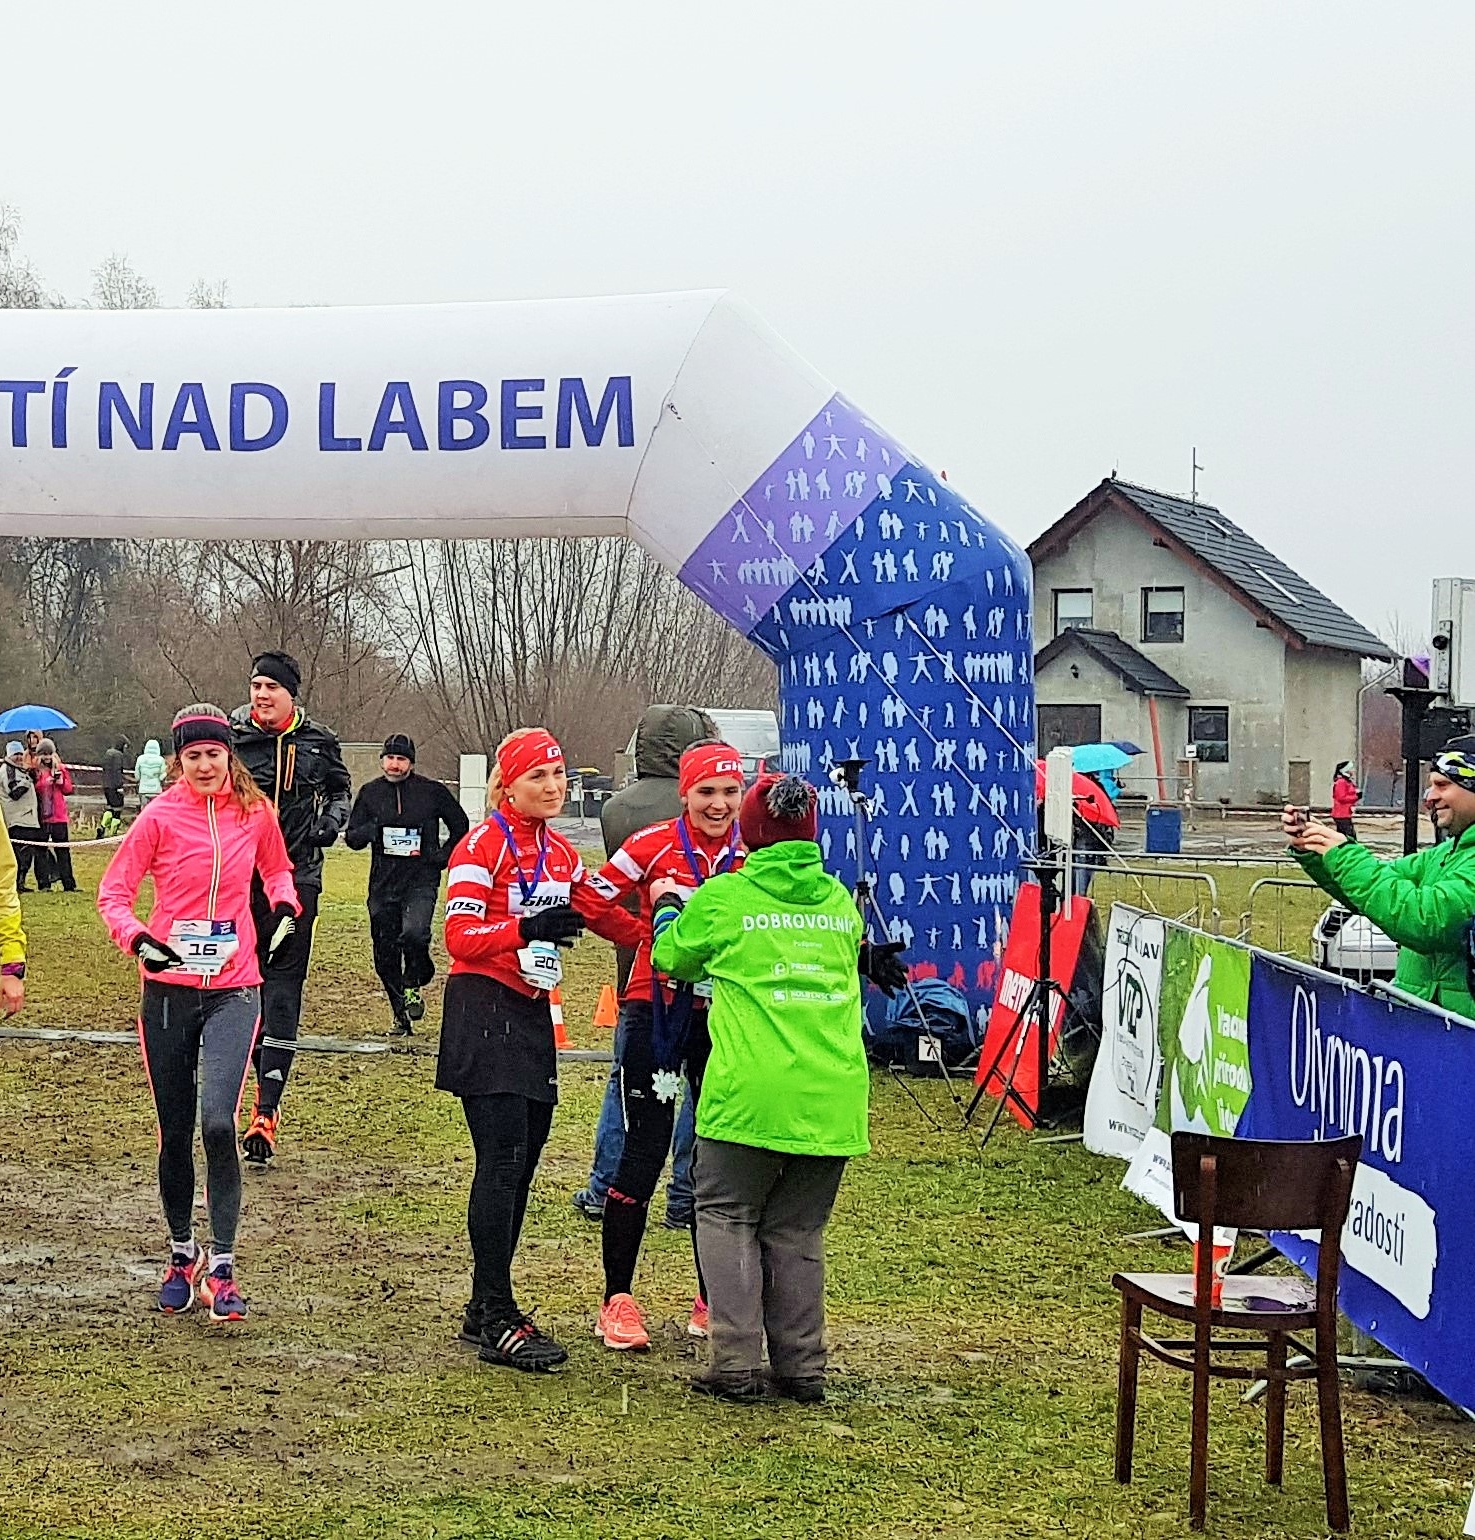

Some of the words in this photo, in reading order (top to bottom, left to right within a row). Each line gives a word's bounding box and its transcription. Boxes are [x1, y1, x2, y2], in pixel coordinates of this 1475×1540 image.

[98, 381, 288, 451] NAD
[320, 376, 635, 451] LABEM
[188, 943, 217, 955] 16
[1291, 985, 1404, 1162] Olympia
